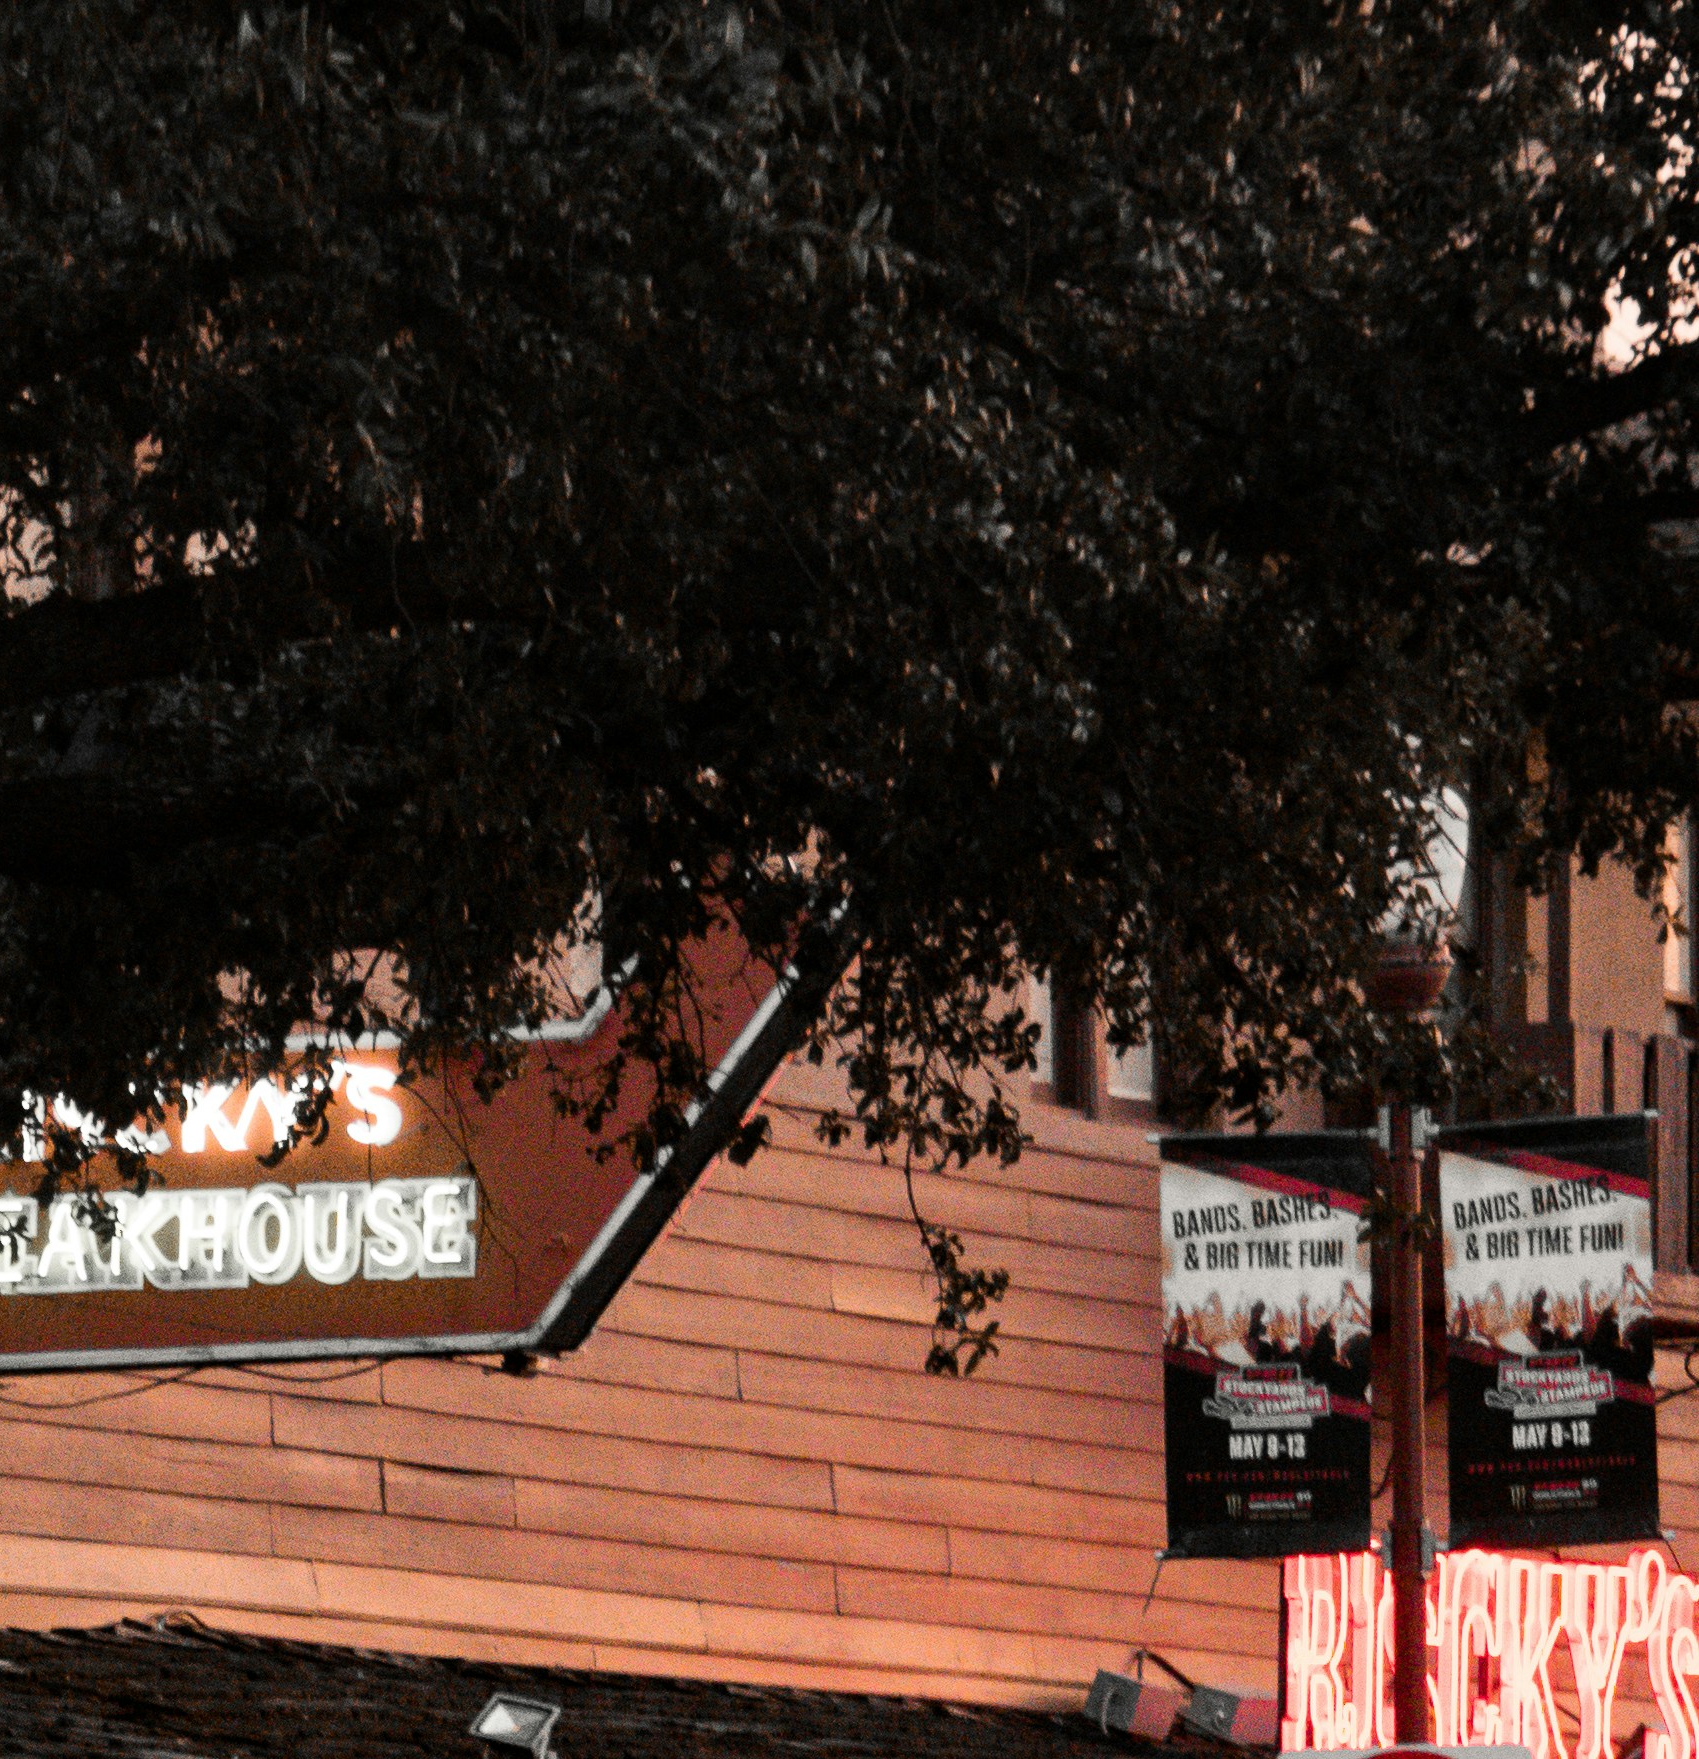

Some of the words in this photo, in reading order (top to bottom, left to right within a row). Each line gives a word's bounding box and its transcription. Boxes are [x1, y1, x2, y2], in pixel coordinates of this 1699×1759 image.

[1172, 1203, 1247, 1239] BANDS.
[1252, 1190, 1339, 1229] BASHES.
[1453, 1191, 1528, 1231] BANDS.
[1531, 1175, 1618, 1217] BASHES.
[1184, 1241, 1199, 1271] &
[1206, 1240, 1239, 1270] BIG
[1246, 1240, 1292, 1270] TIME
[1299, 1239, 1344, 1268] FUN!
[1465, 1232, 1480, 1261] &
[1486, 1229, 1520, 1259] BIG
[1526, 1225, 1573, 1257] TIME
[1579, 1222, 1624, 1253] FUN!
[1229, 1433, 1263, 1459] MAY
[1512, 1422, 1547, 1449] MAY
